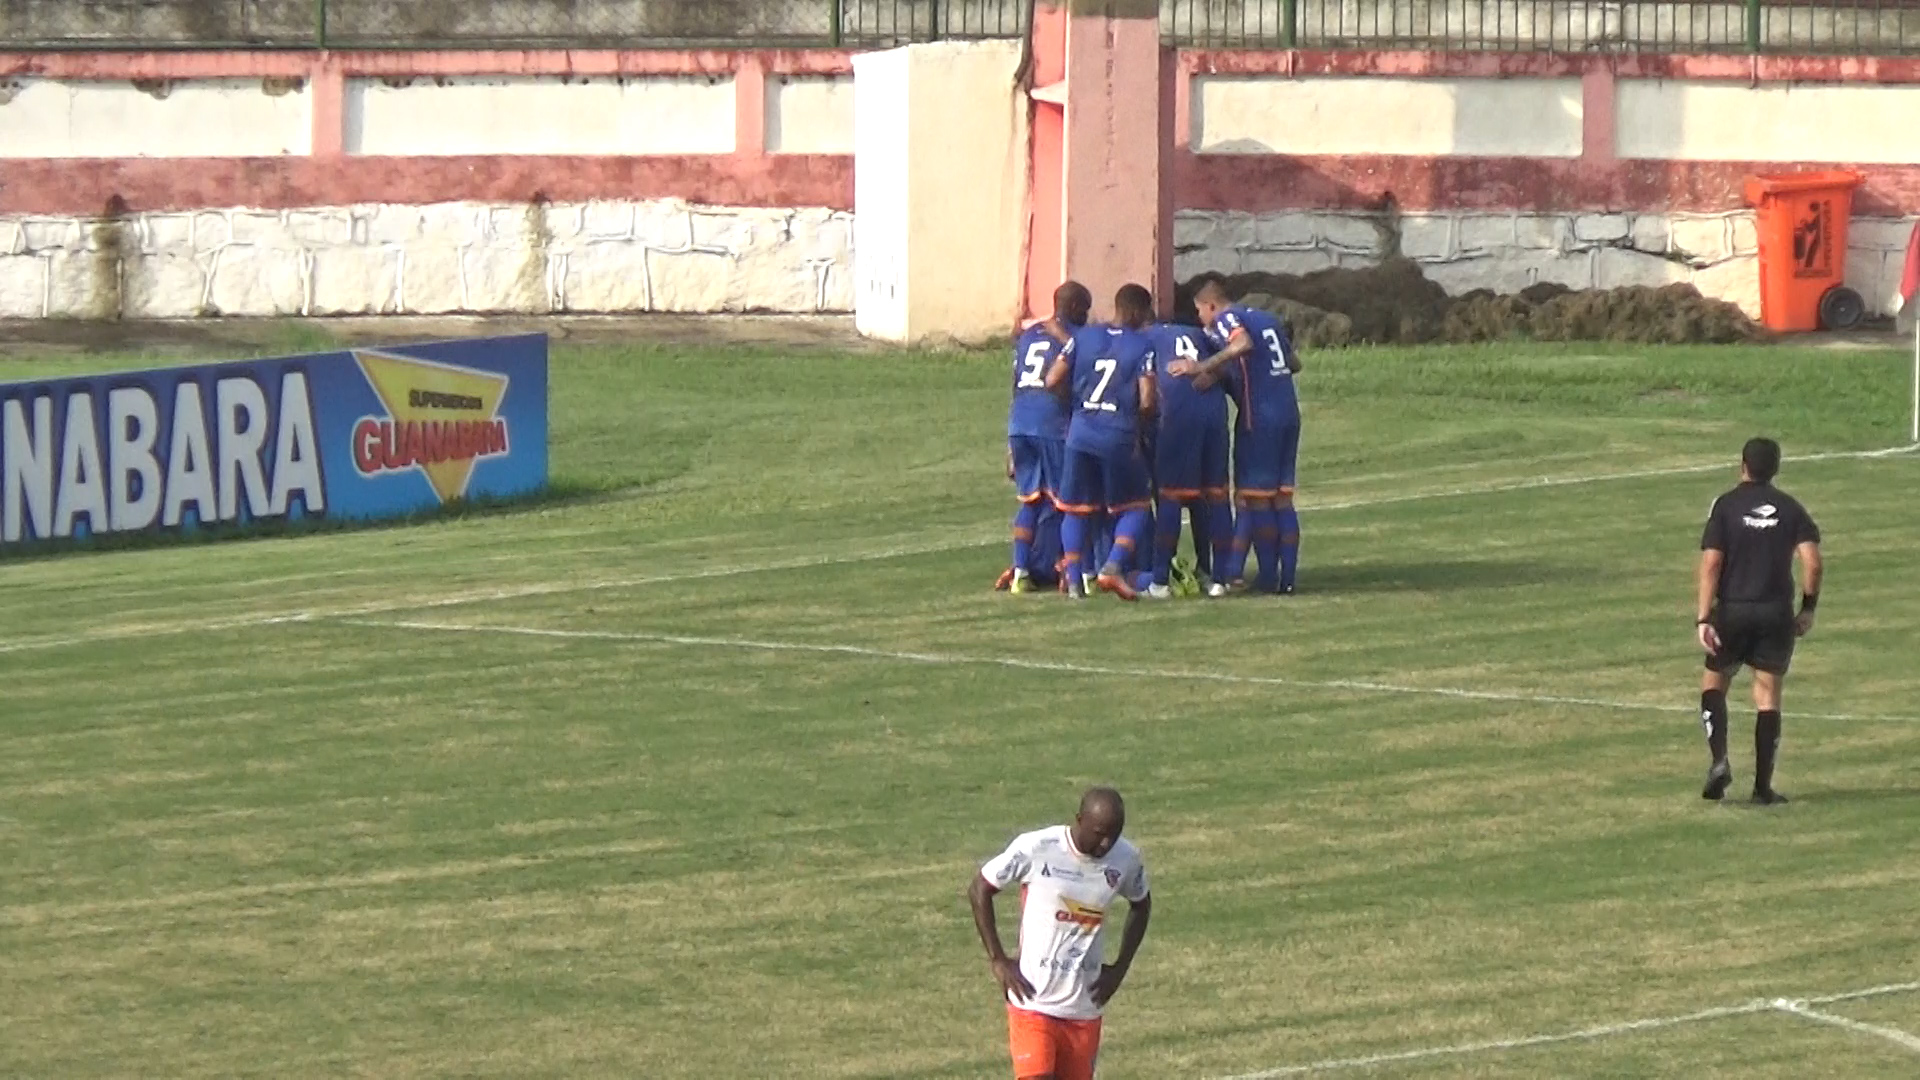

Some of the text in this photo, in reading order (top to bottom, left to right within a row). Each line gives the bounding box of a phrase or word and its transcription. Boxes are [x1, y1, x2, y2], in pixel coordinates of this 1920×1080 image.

[1021, 341, 1051, 382] 5
[1174, 335, 1199, 362] 4
[1261, 328, 1286, 369] 3
[1089, 359, 1117, 403] 7
[353, 418, 508, 473] GUANABARA
